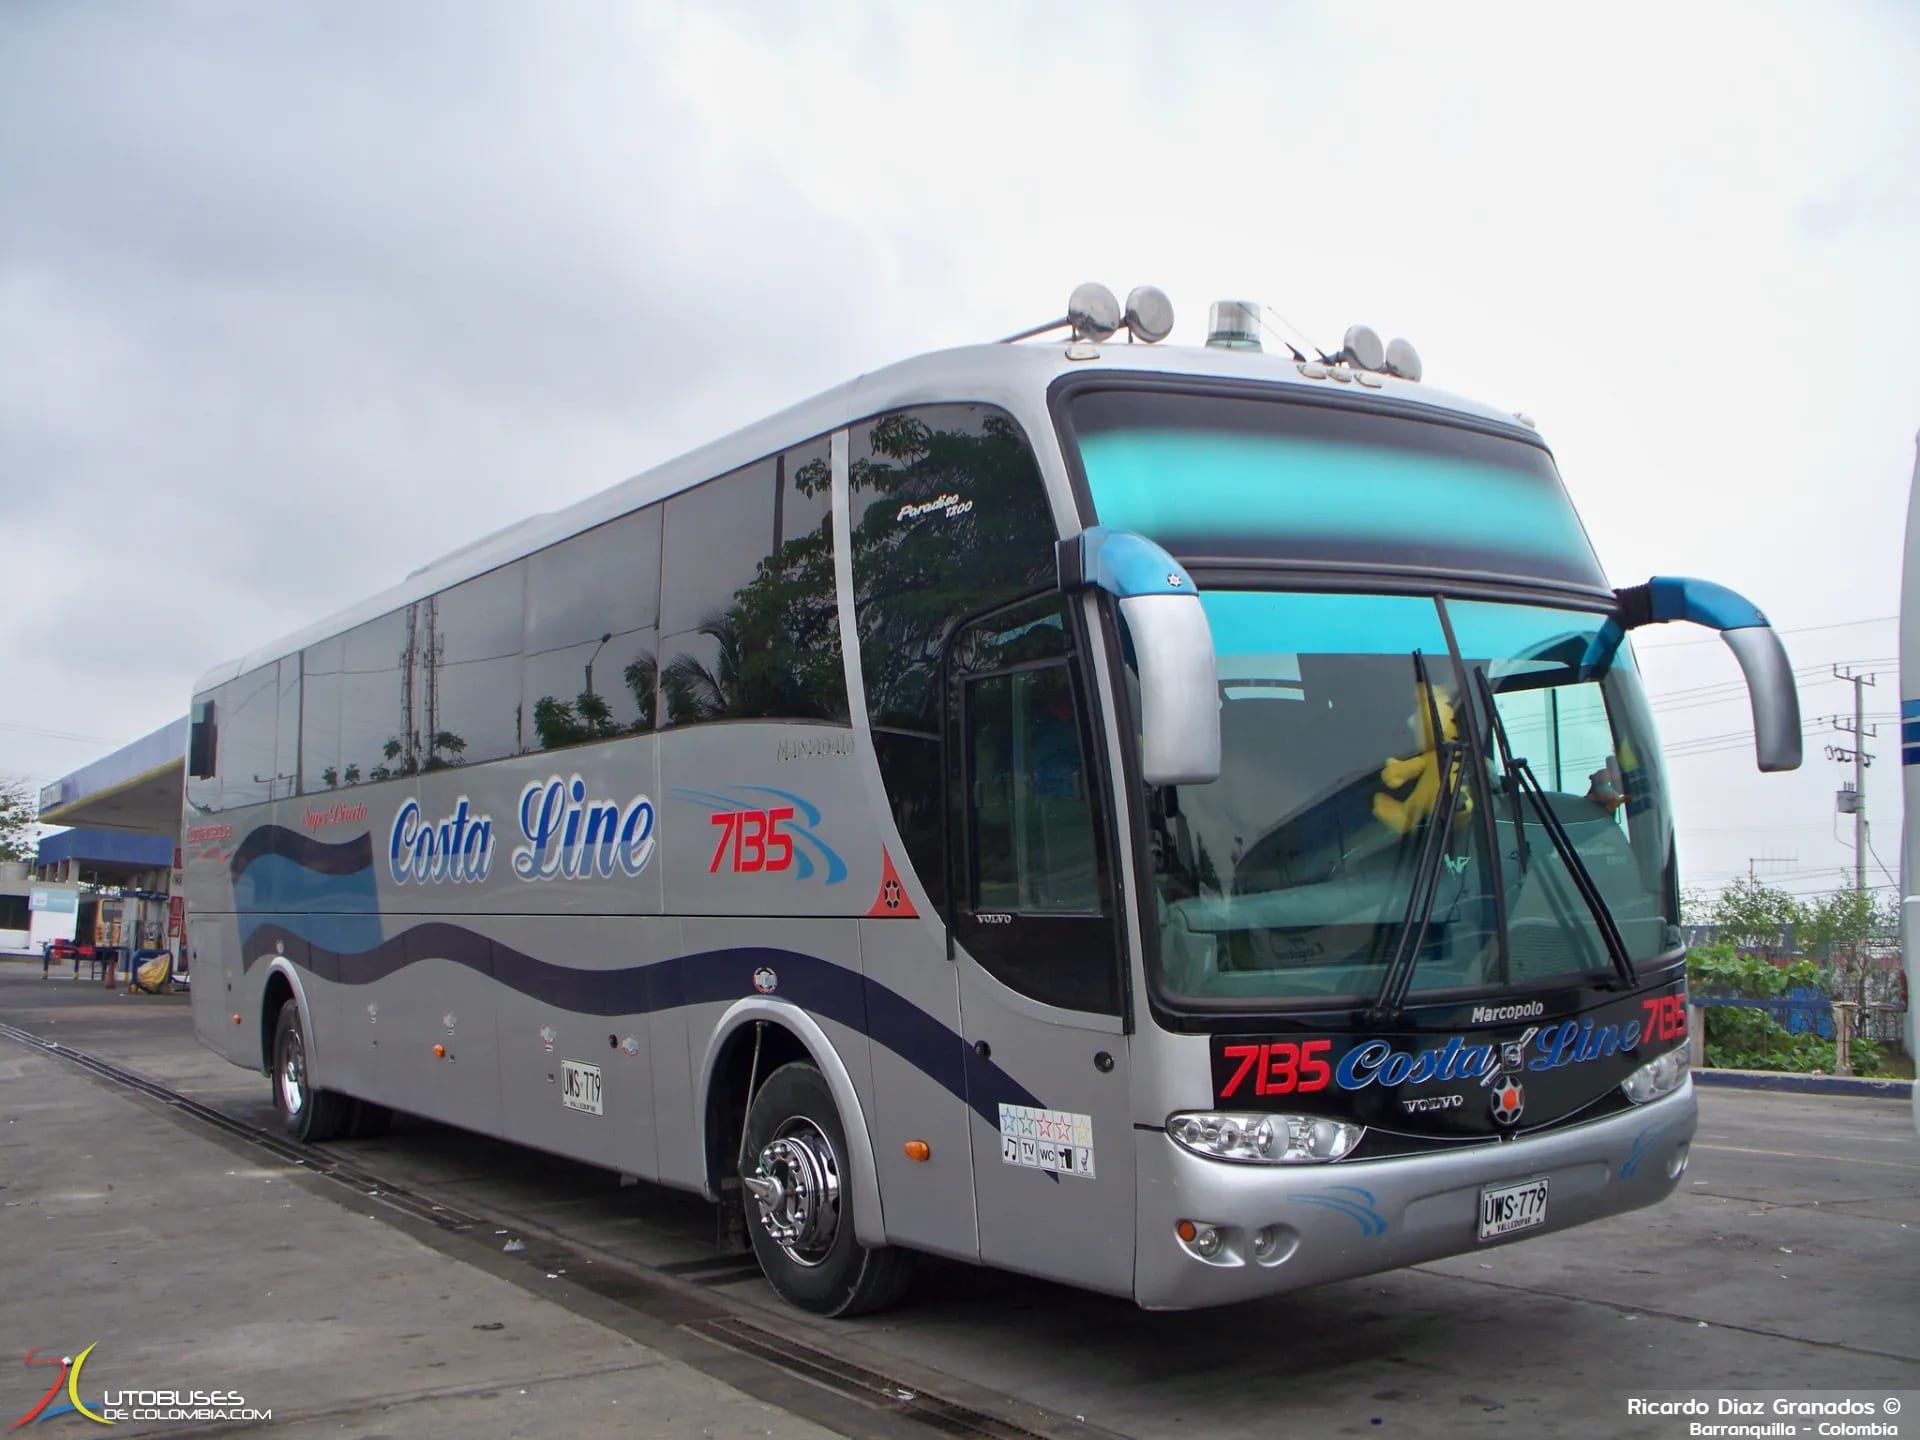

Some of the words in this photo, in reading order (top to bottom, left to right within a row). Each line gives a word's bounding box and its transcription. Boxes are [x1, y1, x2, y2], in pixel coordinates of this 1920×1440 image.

[389, 795, 496, 886] Costa
[511, 772, 656, 882] Line
[708, 807, 794, 873] 7135
[975, 914, 1012, 924] VOLVO
[1472, 1000, 1544, 1023] Marcopolo
[1220, 1039, 1331, 1097] 7135
[1336, 1037, 1497, 1090] Costa
[1528, 1017, 1642, 1072] Line
[1641, 993, 1688, 1044] 7135
[1403, 1095, 1464, 1113] VOLVO
[1022, 1142, 1035, 1156] TV
[1040, 1148, 1055, 1162] WC
